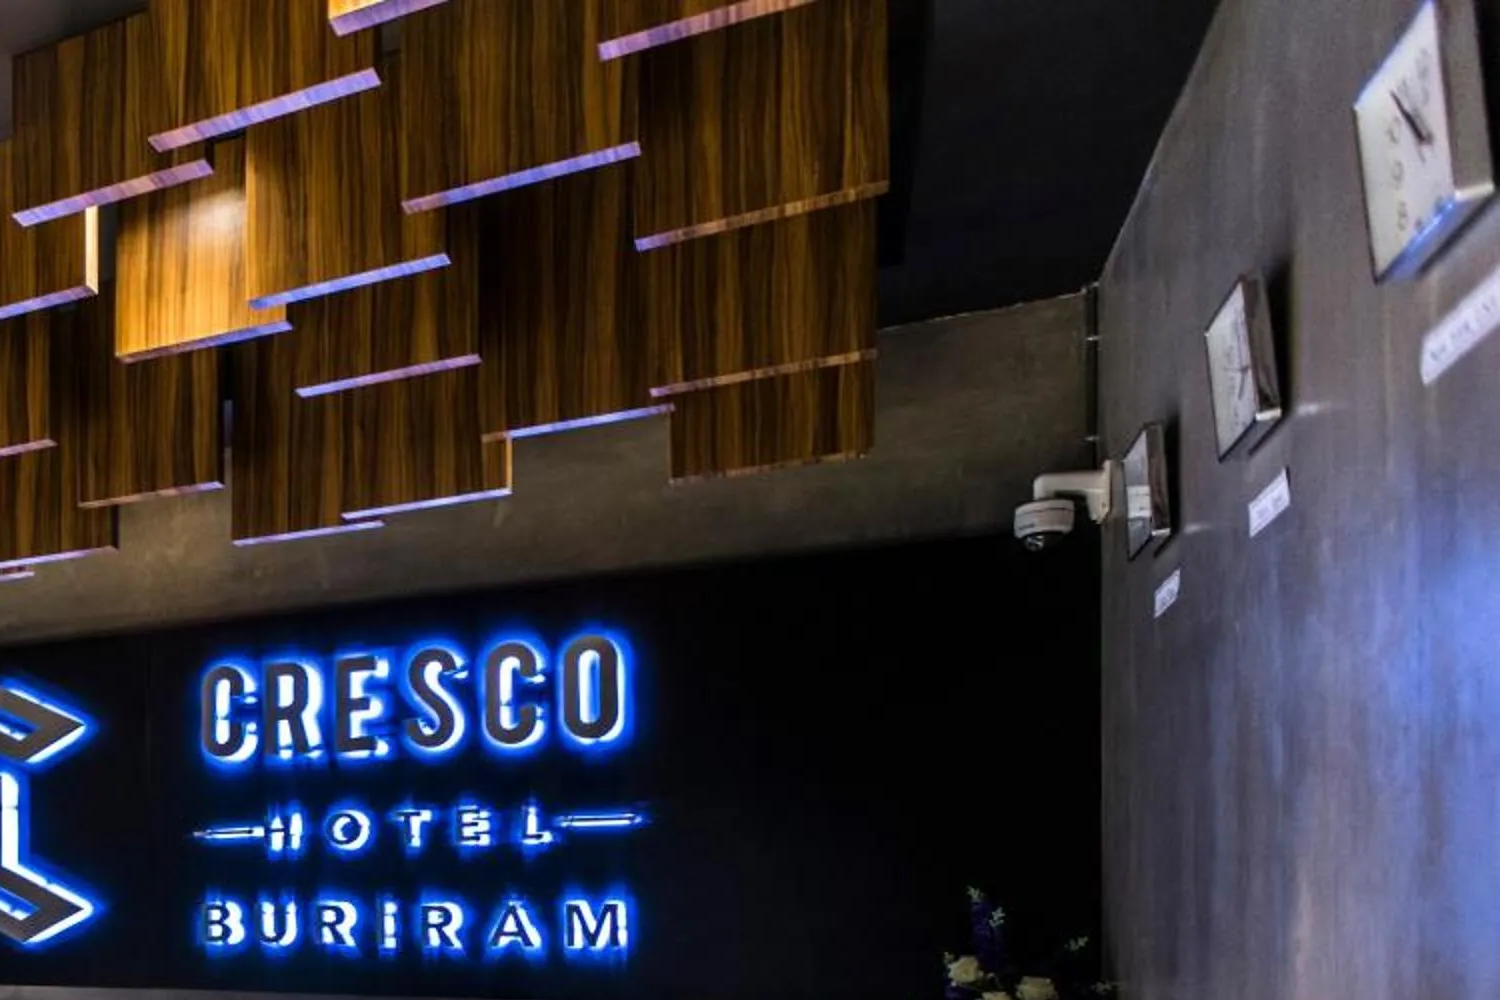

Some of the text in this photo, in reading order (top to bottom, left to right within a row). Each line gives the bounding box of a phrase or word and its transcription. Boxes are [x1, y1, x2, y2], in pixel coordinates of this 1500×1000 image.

[201, 634, 626, 763] CRESCO
[265, 803, 552, 850] HOTEL
[203, 899, 629, 949] BURIRAM
